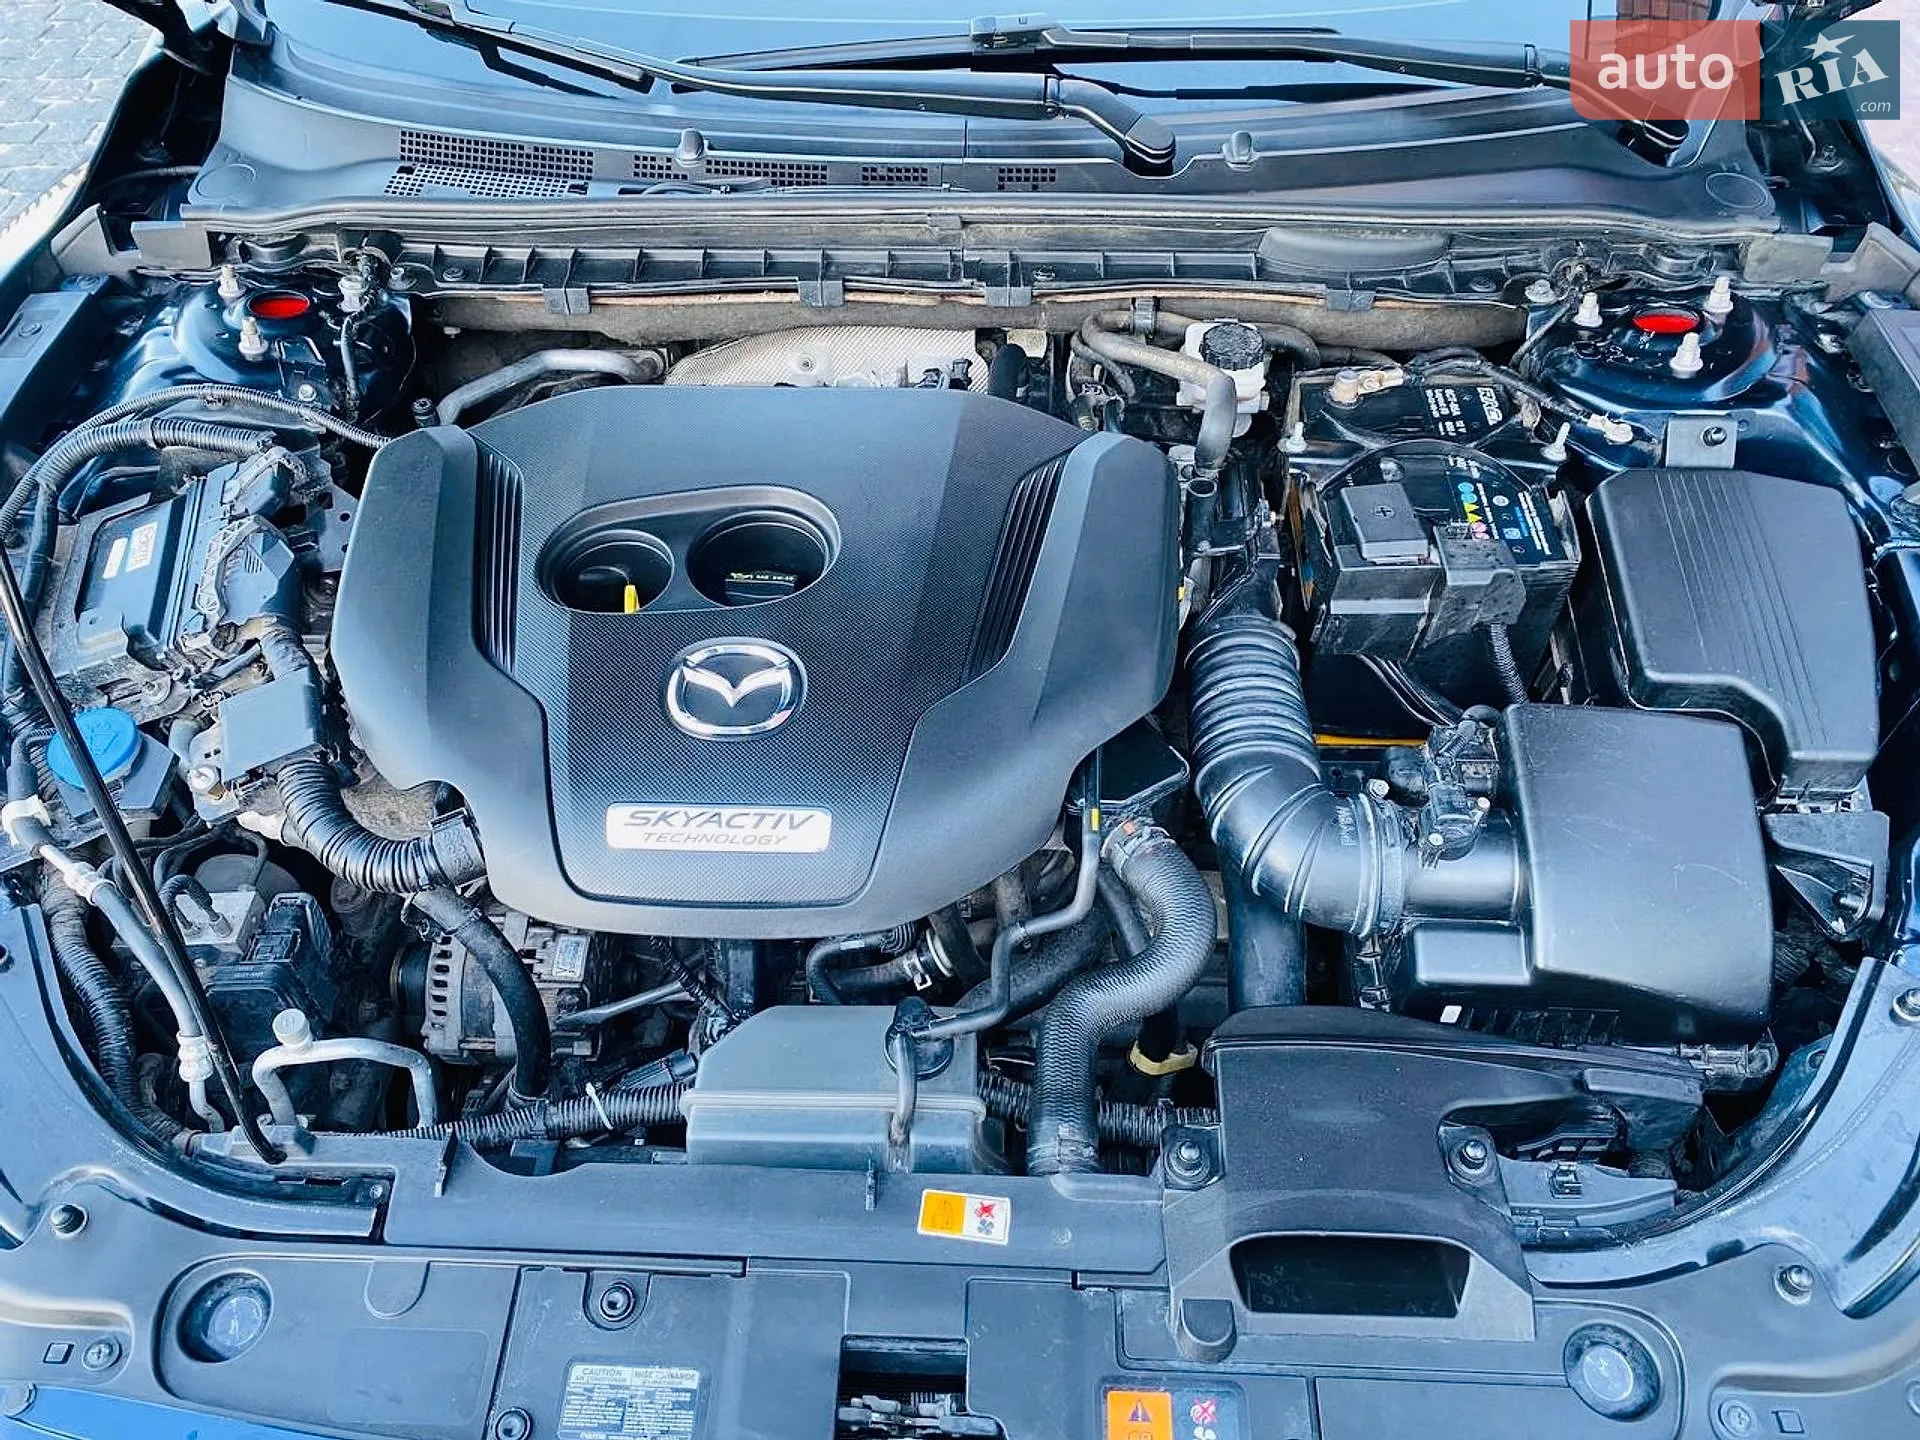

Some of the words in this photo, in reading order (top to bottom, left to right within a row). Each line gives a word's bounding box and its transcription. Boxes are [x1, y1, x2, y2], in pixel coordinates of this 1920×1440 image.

[624, 810, 815, 830] SKYACTIV
[643, 831, 788, 846] TECHNOLOGY
[582, 1367, 623, 1377] CAUTION
